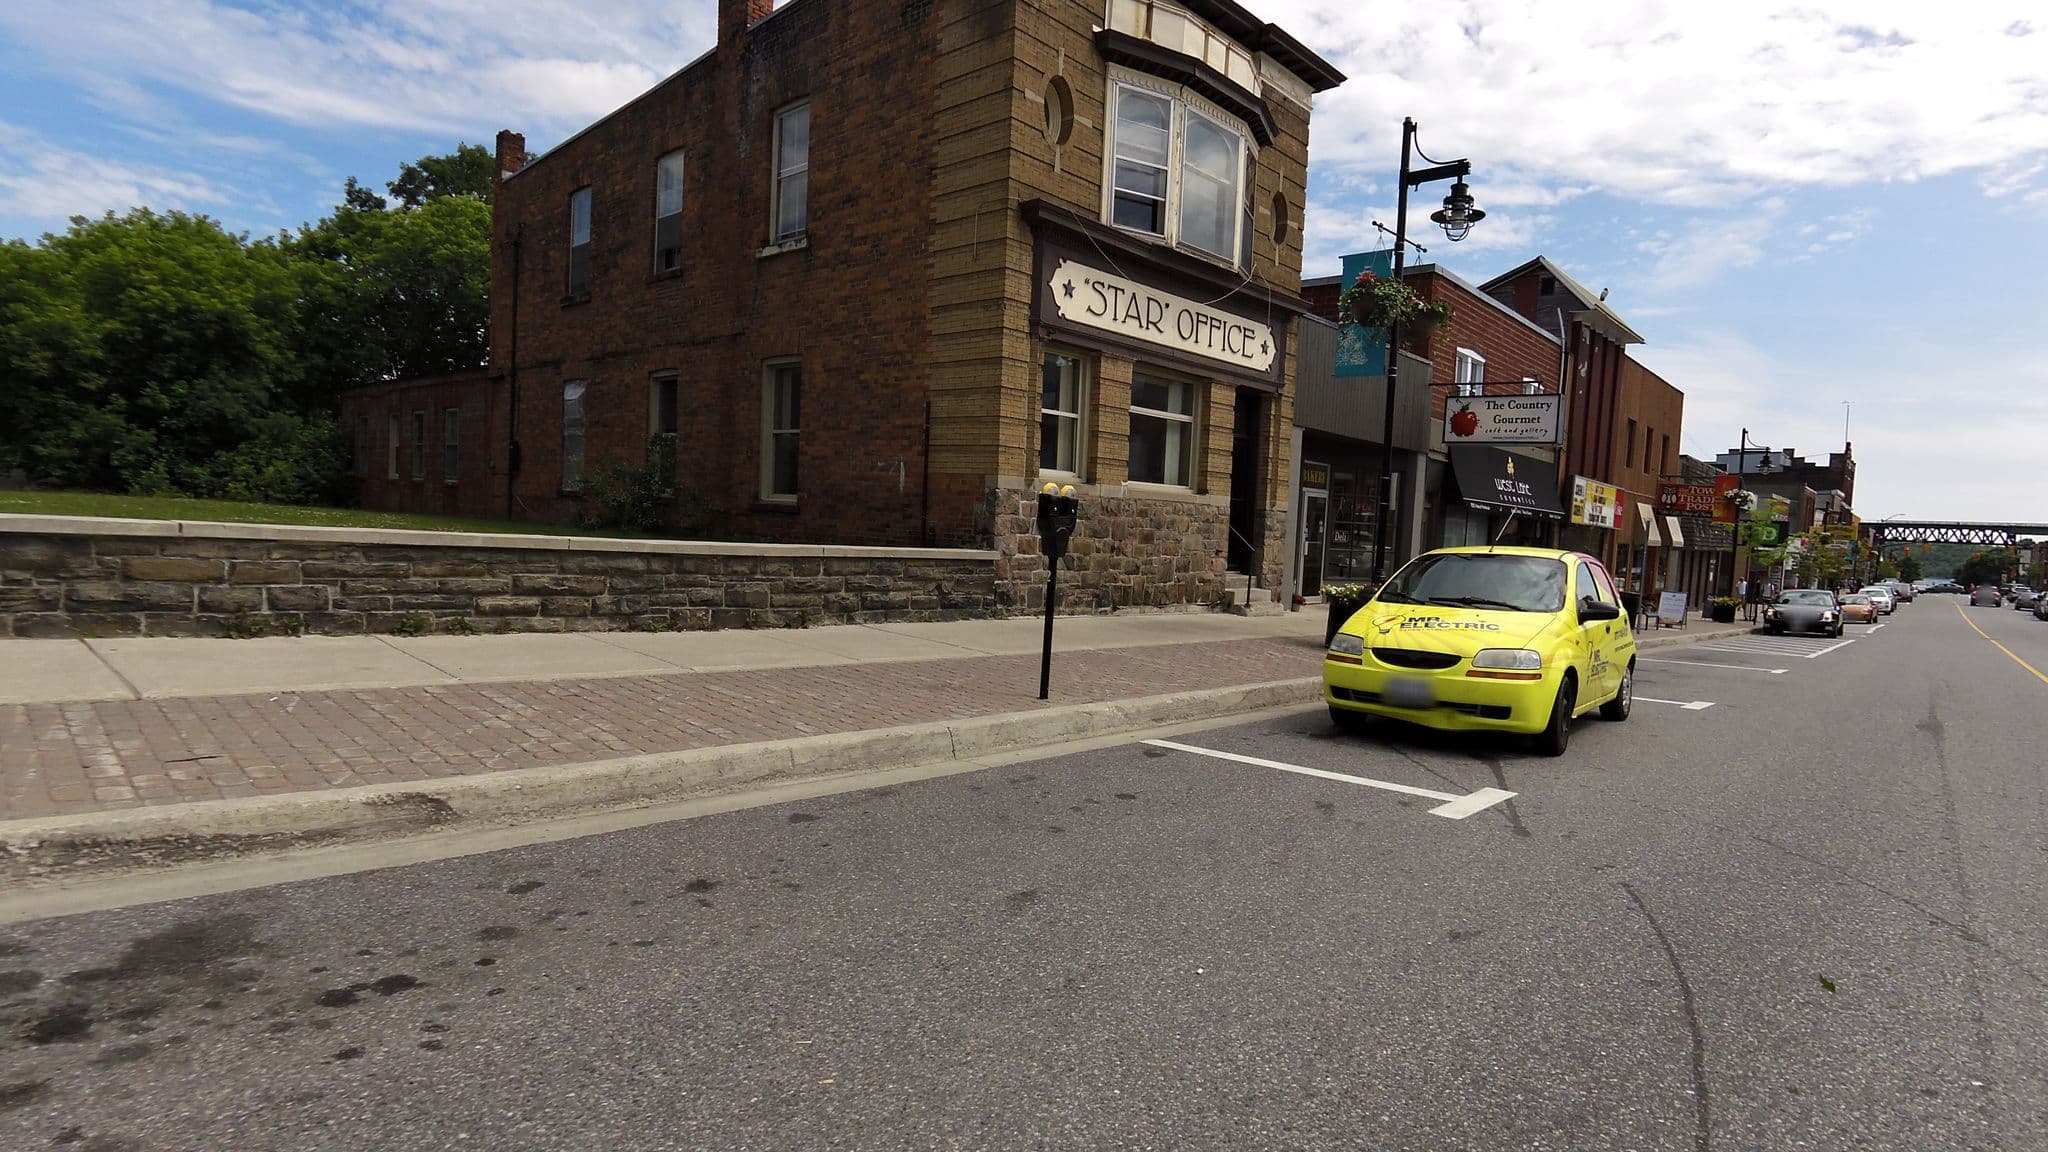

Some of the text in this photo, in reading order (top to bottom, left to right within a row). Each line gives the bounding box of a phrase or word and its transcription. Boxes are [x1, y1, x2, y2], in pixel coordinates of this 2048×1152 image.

[1177, 309, 1257, 358] OFFICE
[1485, 400, 1552, 411] The Country
[1493, 415, 1541, 424] Gourmet
[1520, 427, 1548, 437] gallery
[1689, 485, 1715, 494] TOW
[1400, 622, 1501, 630] ELECTRIC
